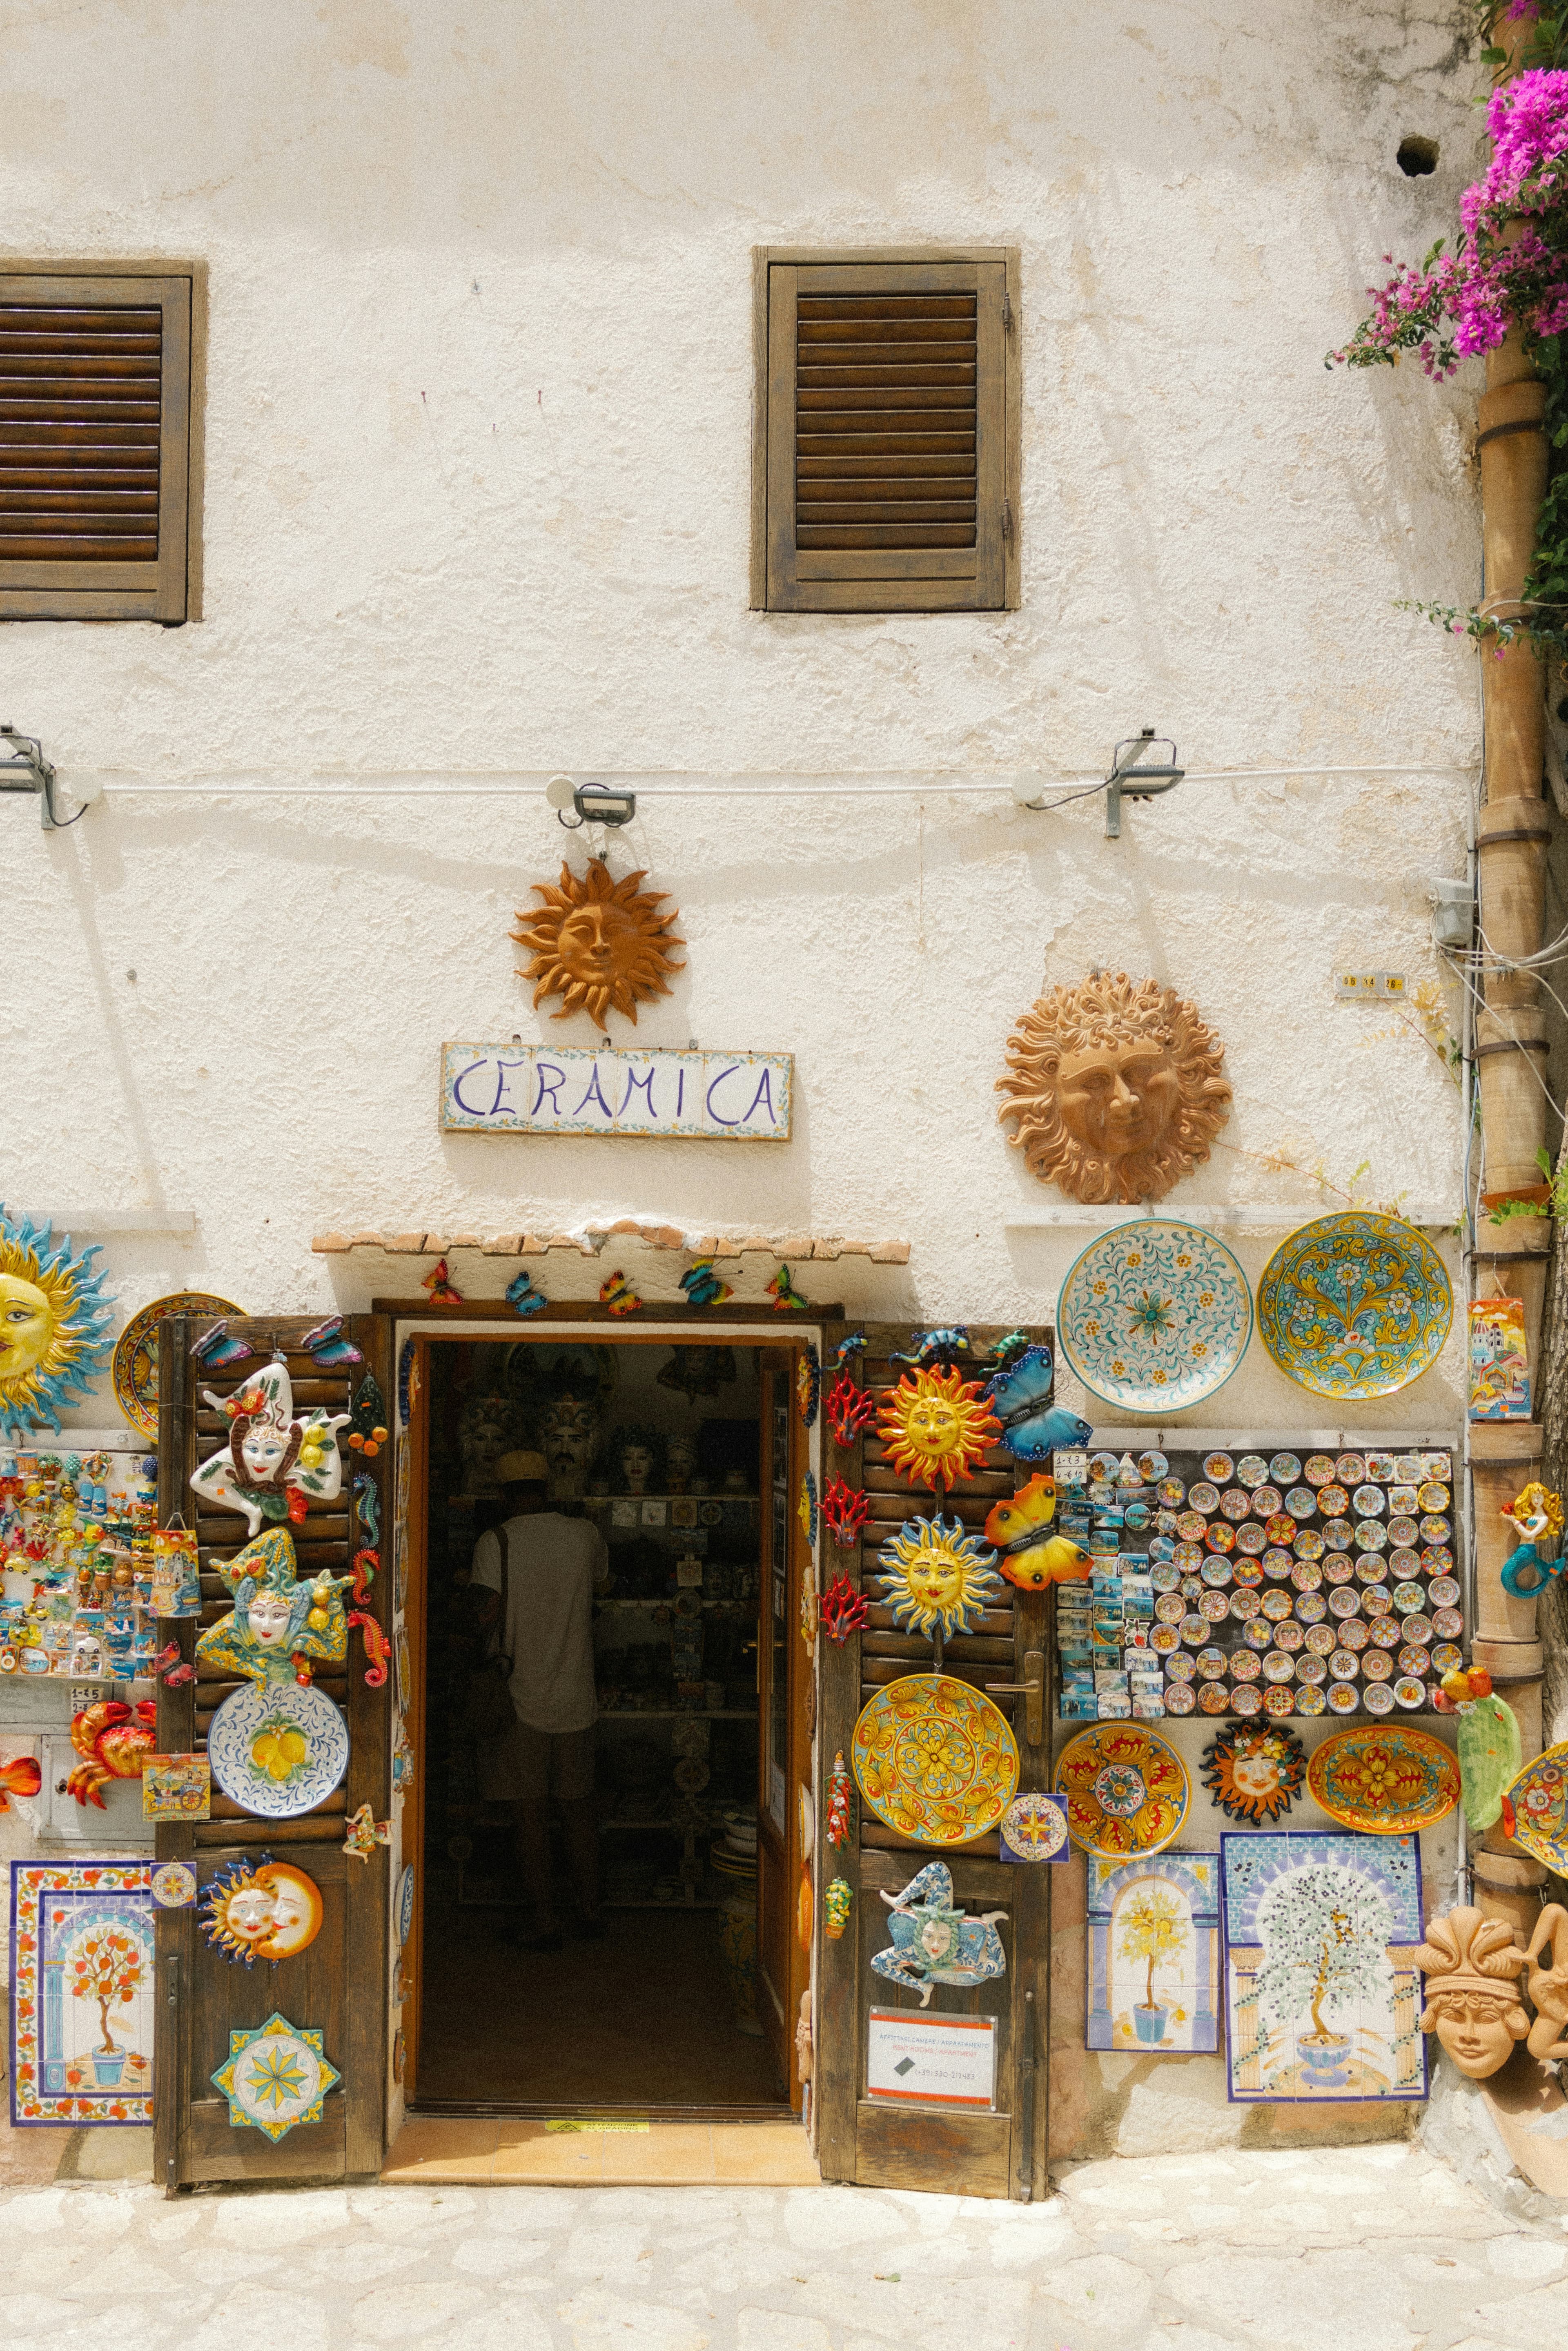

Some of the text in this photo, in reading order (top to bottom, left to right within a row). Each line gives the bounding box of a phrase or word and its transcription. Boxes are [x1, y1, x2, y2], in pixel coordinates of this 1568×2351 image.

[453, 1059, 777, 1126] CERAMICA
[1075, 1455, 1080, 1464] 3
[92, 1689, 99, 1699] 5
[941, 2040, 989, 2049] APPARTAMENTO
